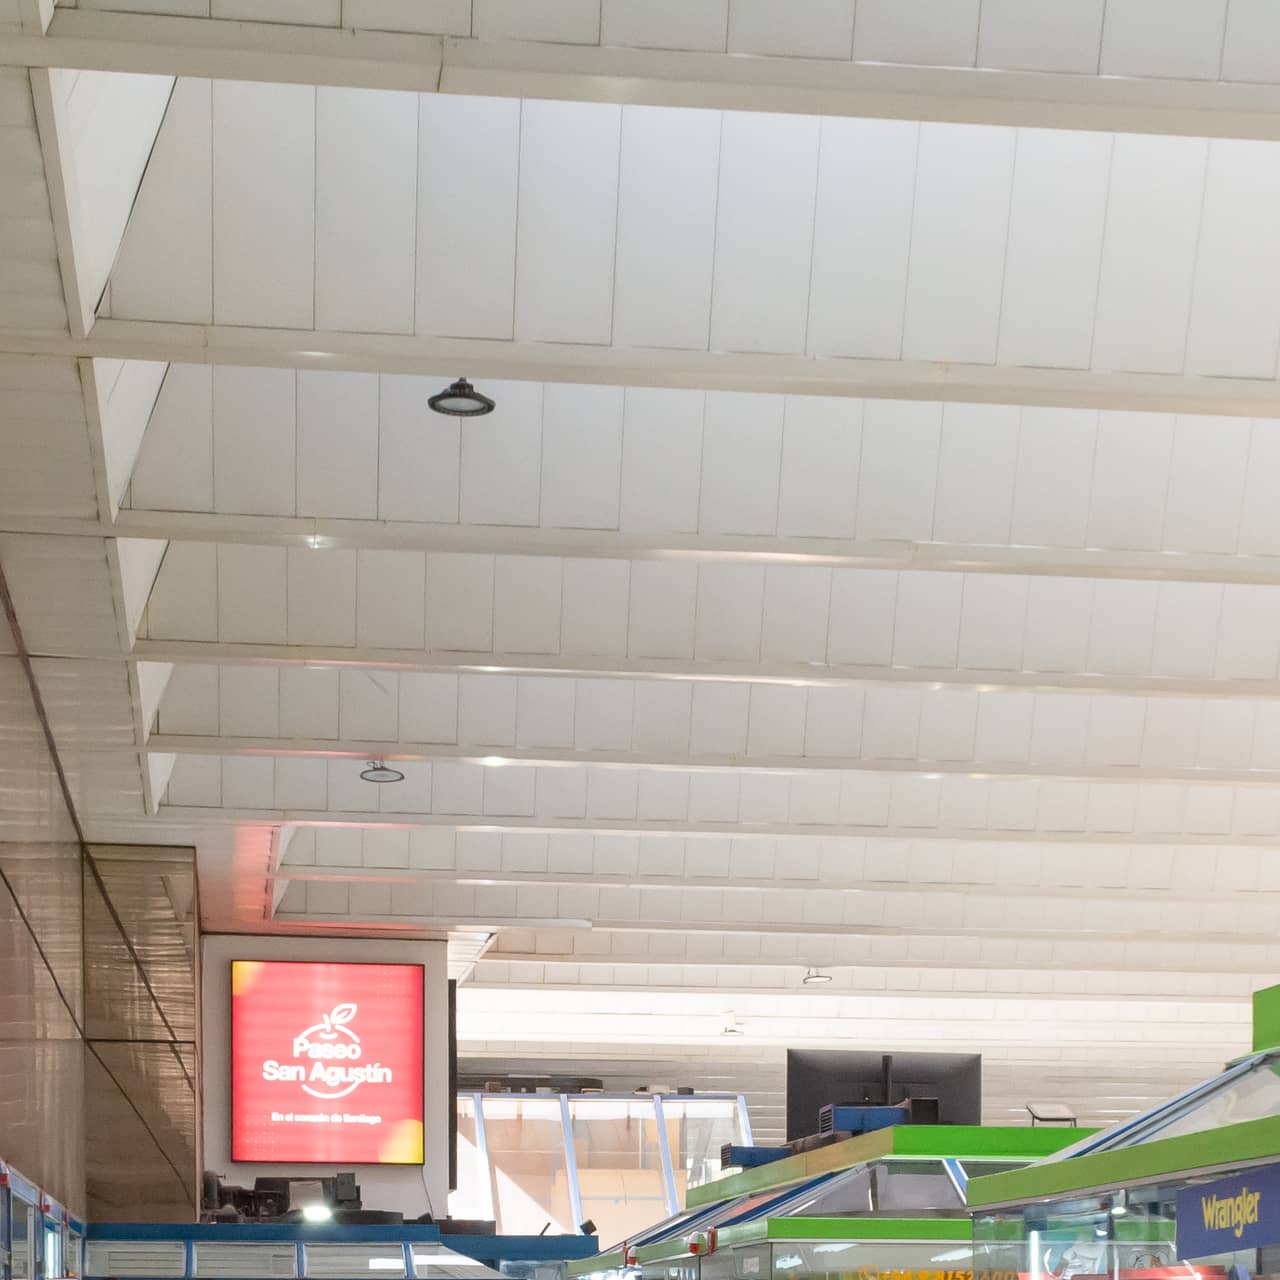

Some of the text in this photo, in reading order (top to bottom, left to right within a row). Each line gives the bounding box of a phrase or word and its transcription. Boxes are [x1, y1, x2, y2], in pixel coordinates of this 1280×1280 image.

[292, 1037, 362, 1060] Paseo
[262, 1059, 393, 1087] San Agustín
[1201, 1187, 1261, 1238] Wrangler
